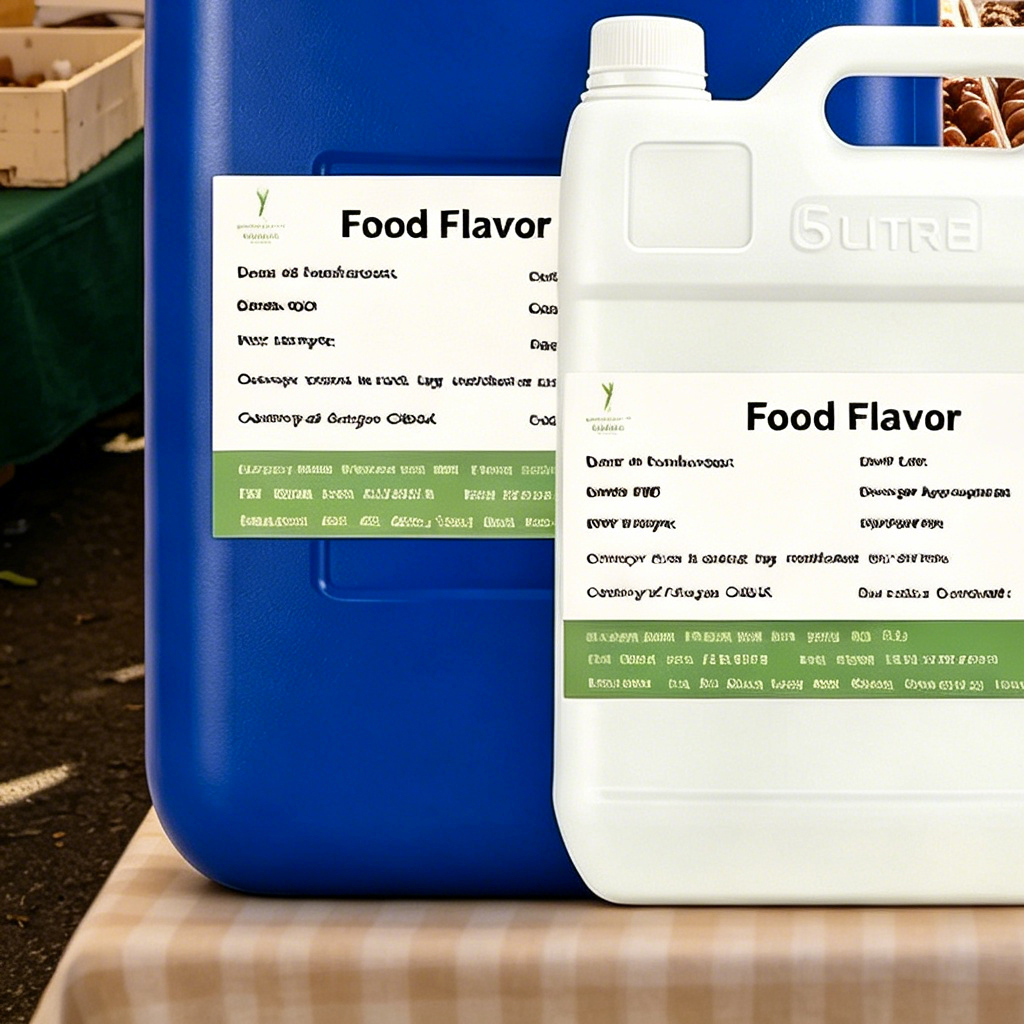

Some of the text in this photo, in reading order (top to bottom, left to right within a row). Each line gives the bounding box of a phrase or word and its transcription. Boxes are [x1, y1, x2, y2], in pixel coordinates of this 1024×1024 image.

[341, 208, 552, 239] Food Flavor
[747, 401, 962, 431] Food Flavor
